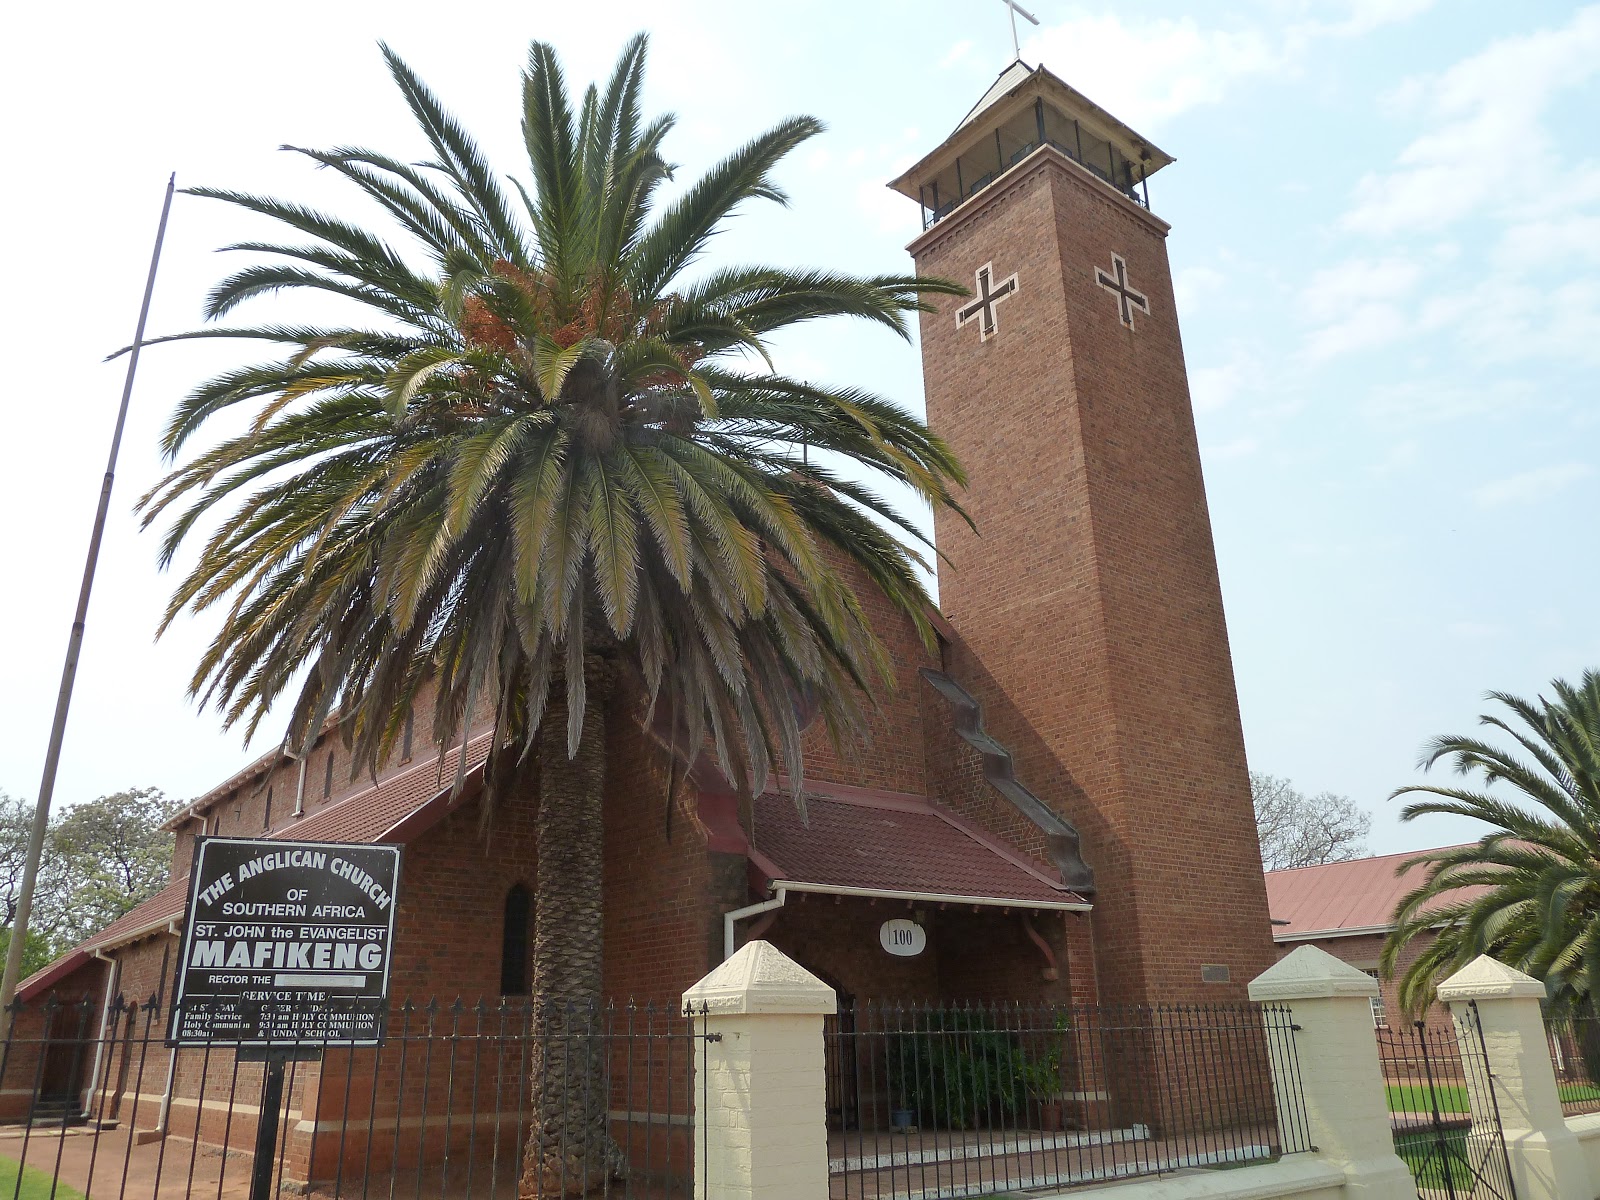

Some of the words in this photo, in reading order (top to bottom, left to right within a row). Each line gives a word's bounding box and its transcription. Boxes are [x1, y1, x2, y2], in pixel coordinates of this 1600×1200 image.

[199, 872, 235, 907] THE
[238, 850, 327, 883] ANGLICAN
[330, 857, 392, 910] CHURCH
[286, 888, 308, 901] OF
[222, 902, 307, 917] SOUTHERN
[311, 905, 366, 918] AFRICA
[195, 924, 218, 937] ST.
[224, 926, 265, 938] JOHN
[271, 927, 294, 938] the
[299, 927, 386, 940] EVANGELIST
[893, 929, 912, 946] 100
[191, 940, 382, 969] MAFIKENG
[208, 975, 249, 984] RECTOR
[252, 975, 272, 985] THE
[185, 1012, 212, 1021] Family
[183, 1021, 203, 1030] Holy
[271, 1030, 303, 1038] UNDA
